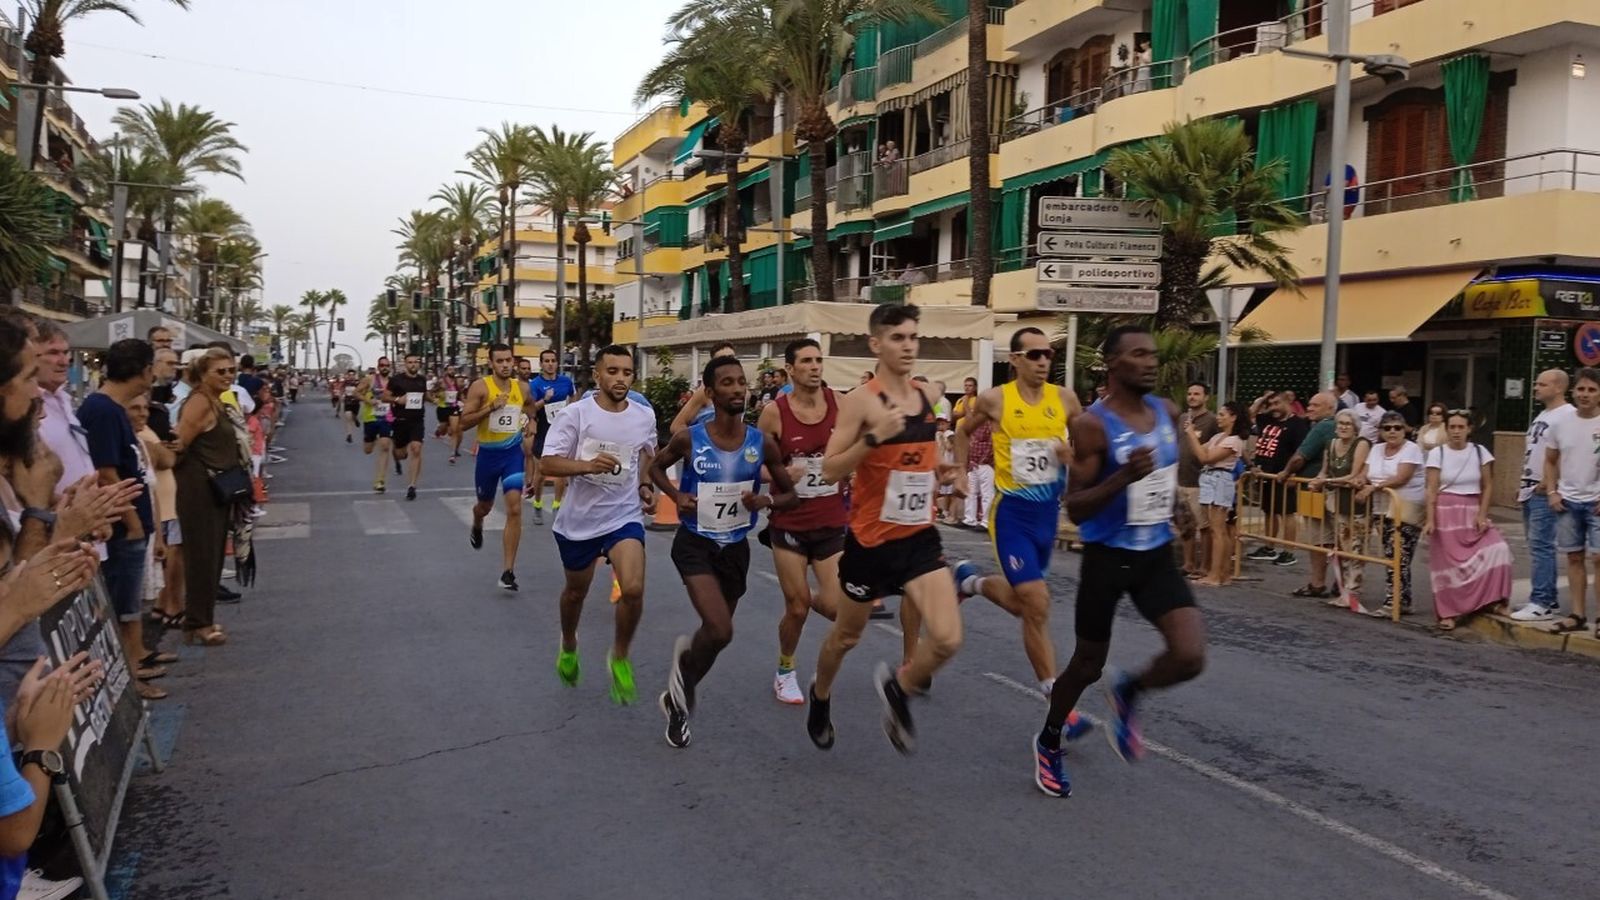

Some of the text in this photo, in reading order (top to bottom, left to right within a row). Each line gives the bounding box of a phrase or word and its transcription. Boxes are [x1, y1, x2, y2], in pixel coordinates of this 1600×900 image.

[1045, 202, 1119, 212] embarcadero
[1045, 214, 1072, 224] lonja
[1064, 240, 1156, 251] Peña Cultural Flamenca
[1078, 267, 1155, 278] polideportivo
[498, 415, 512, 426] 63
[1025, 455, 1048, 472] 30
[714, 501, 738, 519] 74
